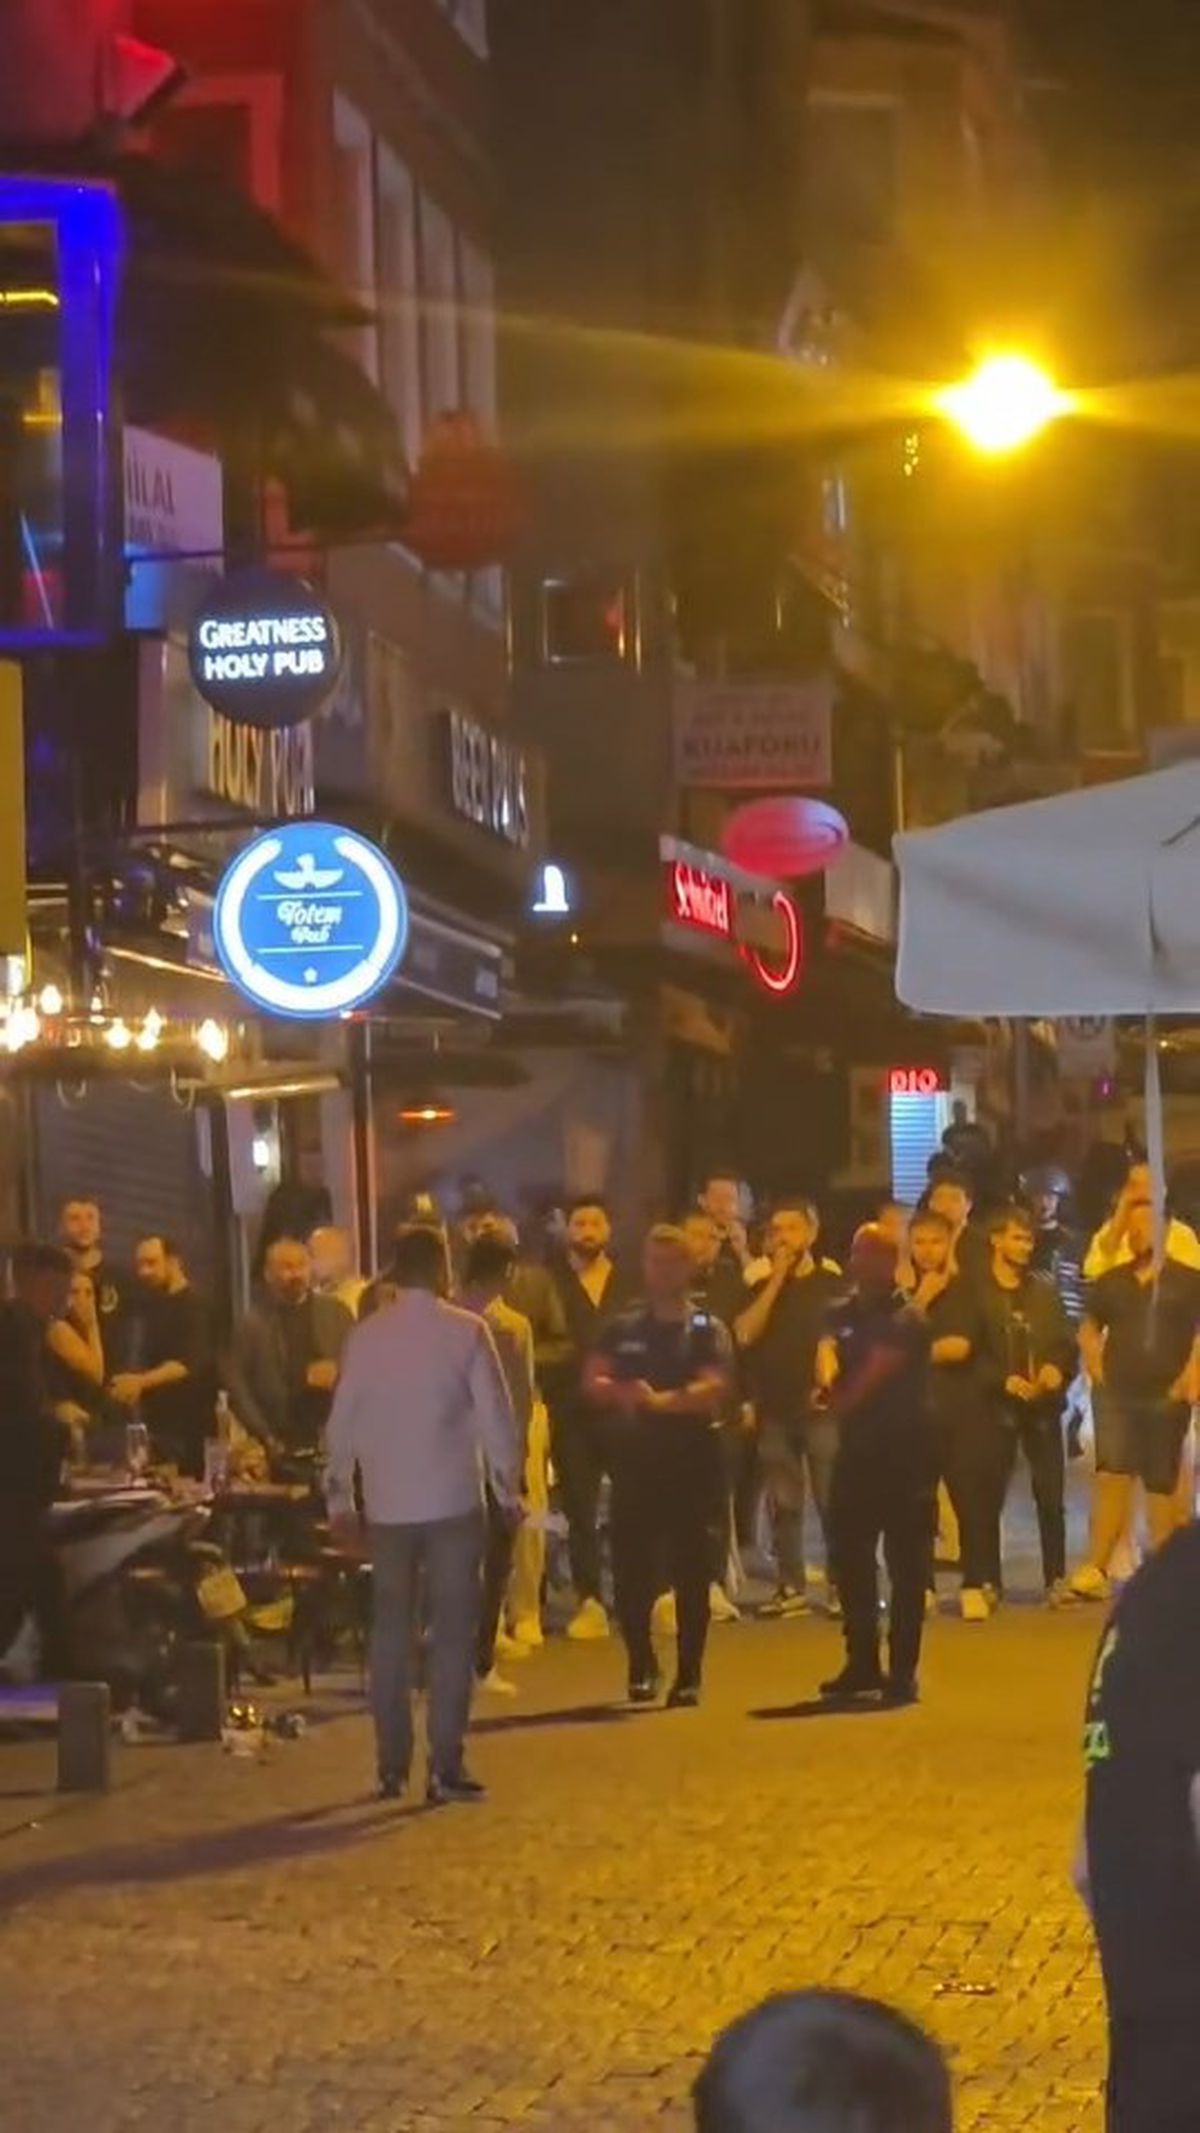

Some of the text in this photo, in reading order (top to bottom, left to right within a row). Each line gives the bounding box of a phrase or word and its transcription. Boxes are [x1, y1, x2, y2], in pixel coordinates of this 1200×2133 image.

[200, 617, 327, 649] GREATNESS
[204, 649, 325, 680] HOLY PUB
[276, 900, 343, 926] Totem
